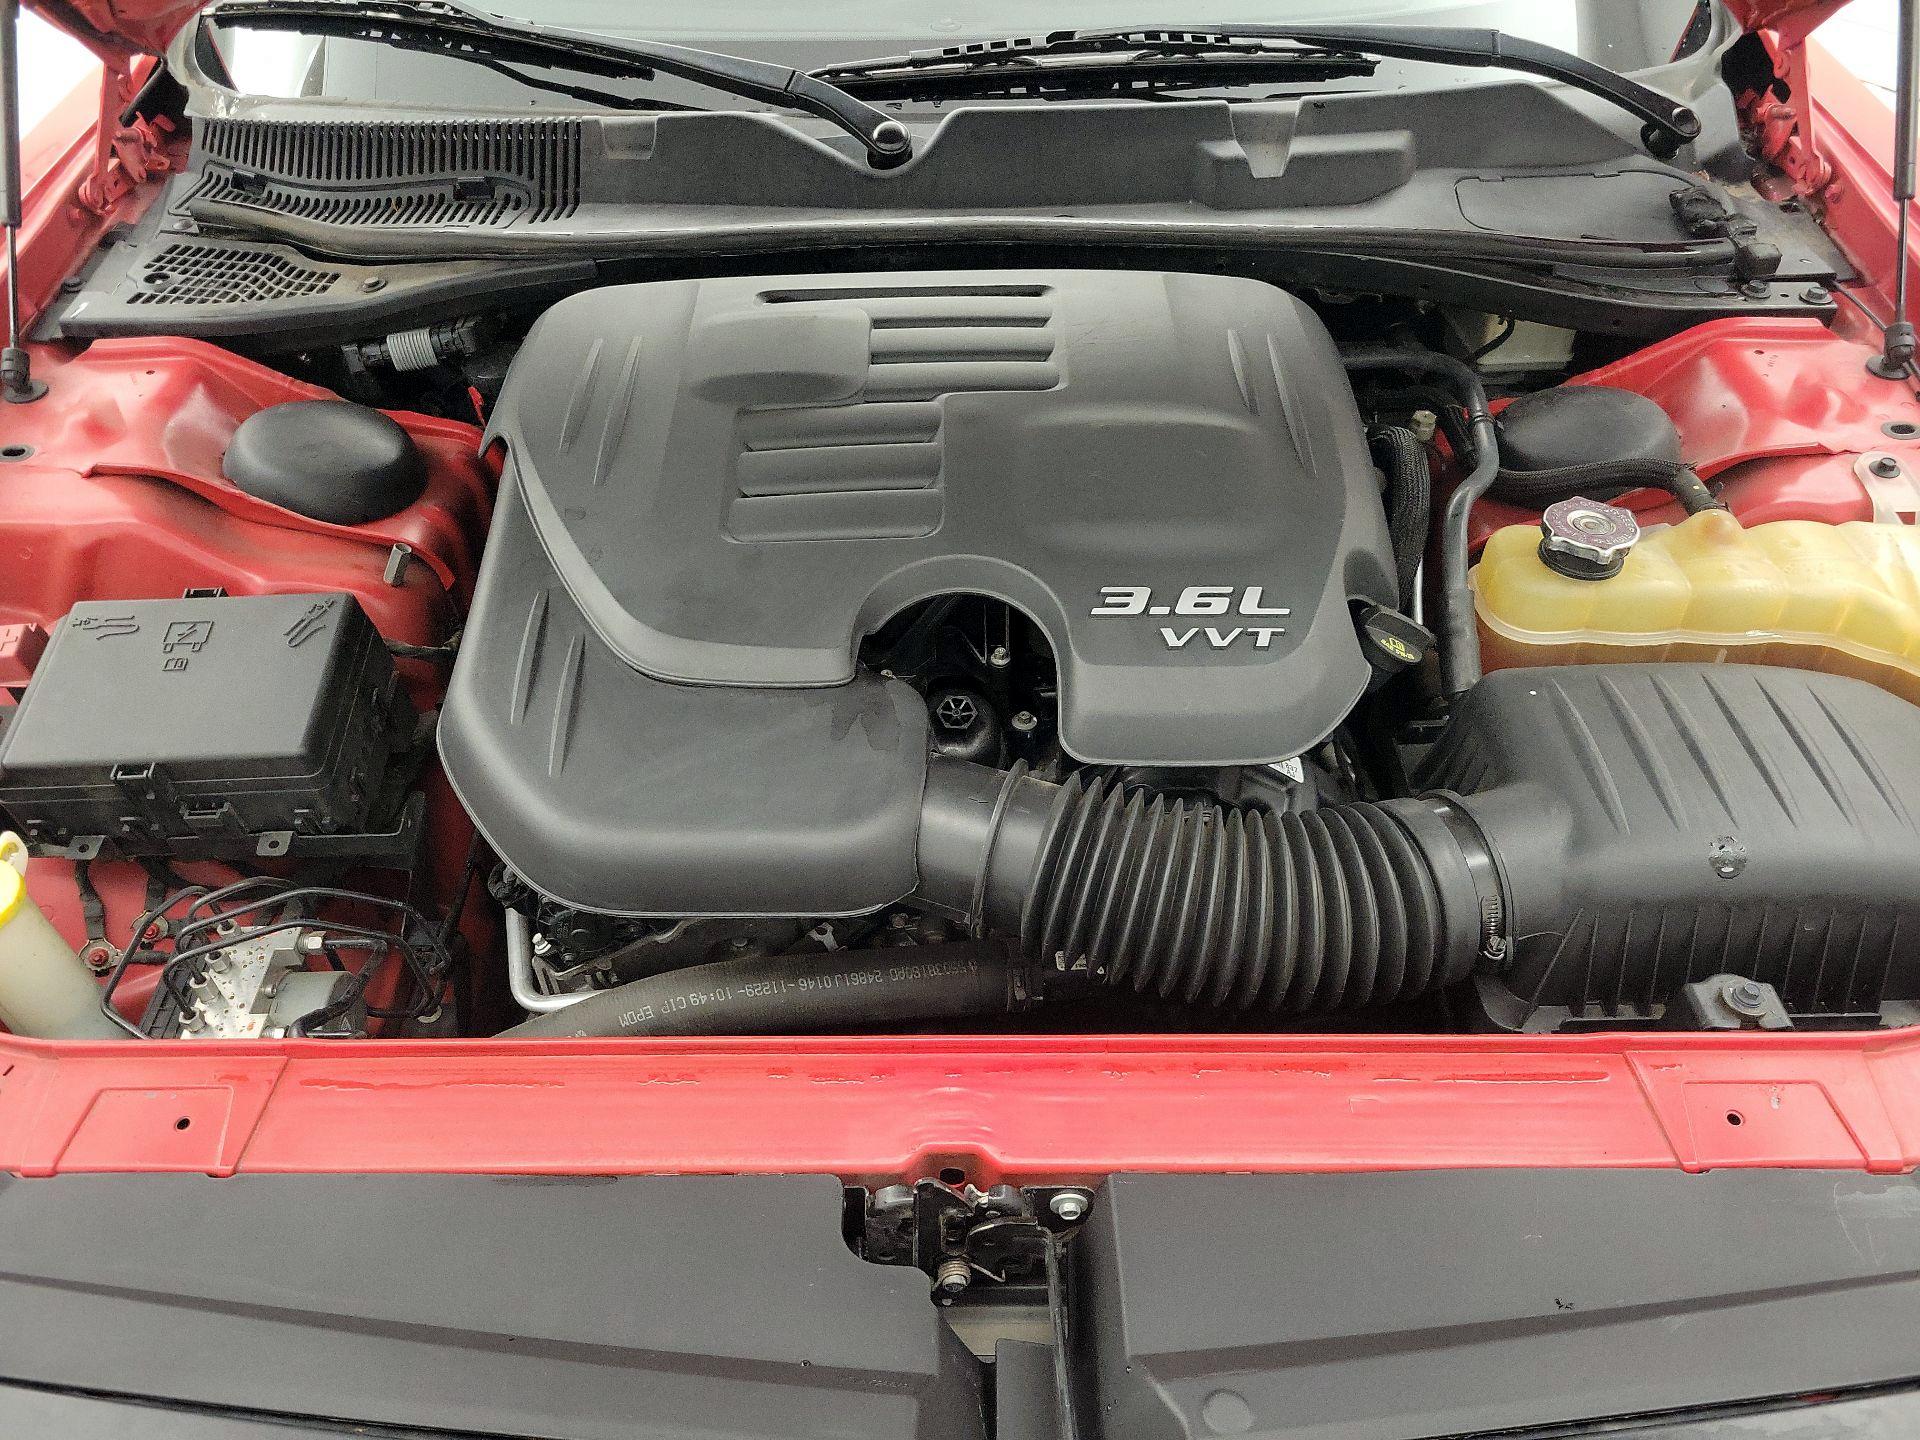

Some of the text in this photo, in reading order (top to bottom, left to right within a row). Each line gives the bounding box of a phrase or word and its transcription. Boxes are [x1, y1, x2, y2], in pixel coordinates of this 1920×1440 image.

[1090, 586, 1291, 615] 3.6L
[1159, 627, 1286, 648] VVT
[620, 1005, 654, 1028] EPDM
